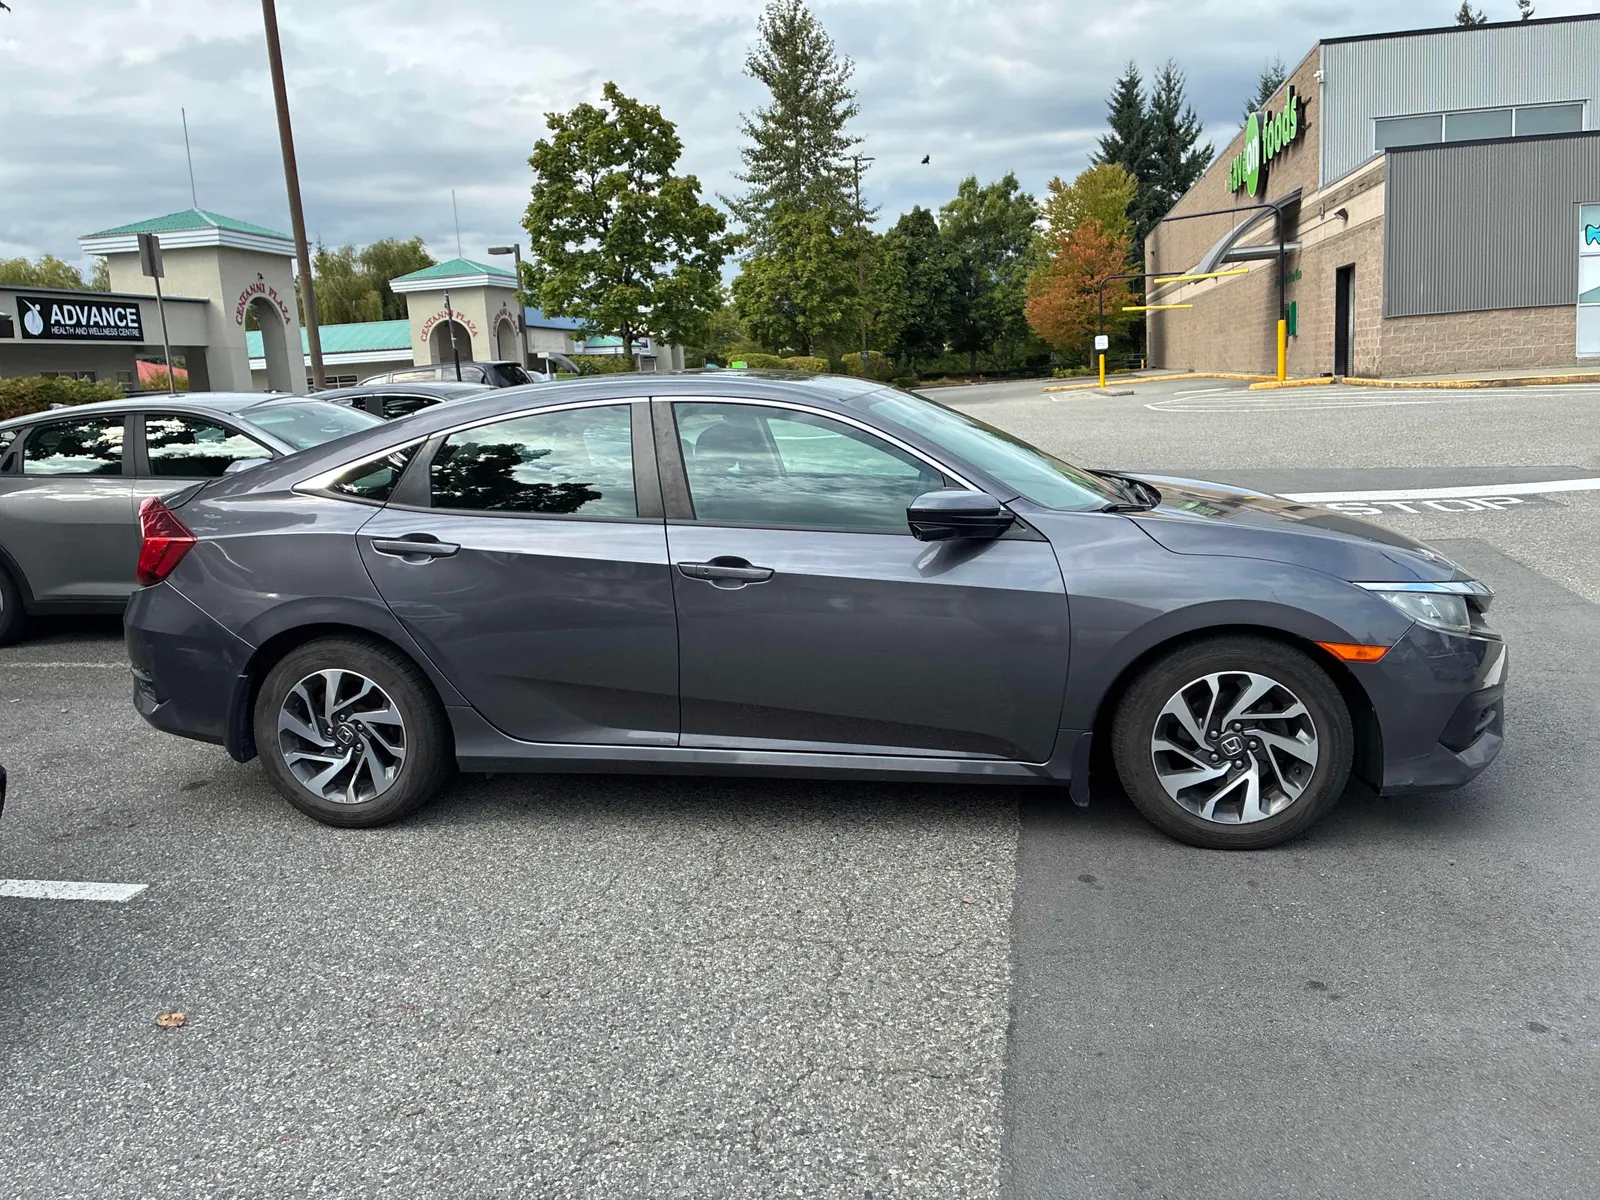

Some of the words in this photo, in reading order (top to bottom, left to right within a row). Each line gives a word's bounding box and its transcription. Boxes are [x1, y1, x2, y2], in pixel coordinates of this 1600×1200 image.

[1246, 135, 1260, 175] on
[1262, 86, 1298, 165] foods
[50, 304, 139, 327] ADVANCE
[236, 283, 266, 326] CENTANNI
[268, 286, 291, 325] PLAZA
[51, 325, 75, 335] HEALTH
[75, 326, 88, 335] AND
[88, 327, 118, 337] WELLNESS
[118, 328, 140, 337] CENTRE
[456, 311, 478, 338] PLAZA
[1326, 496, 1524, 515] STOP
